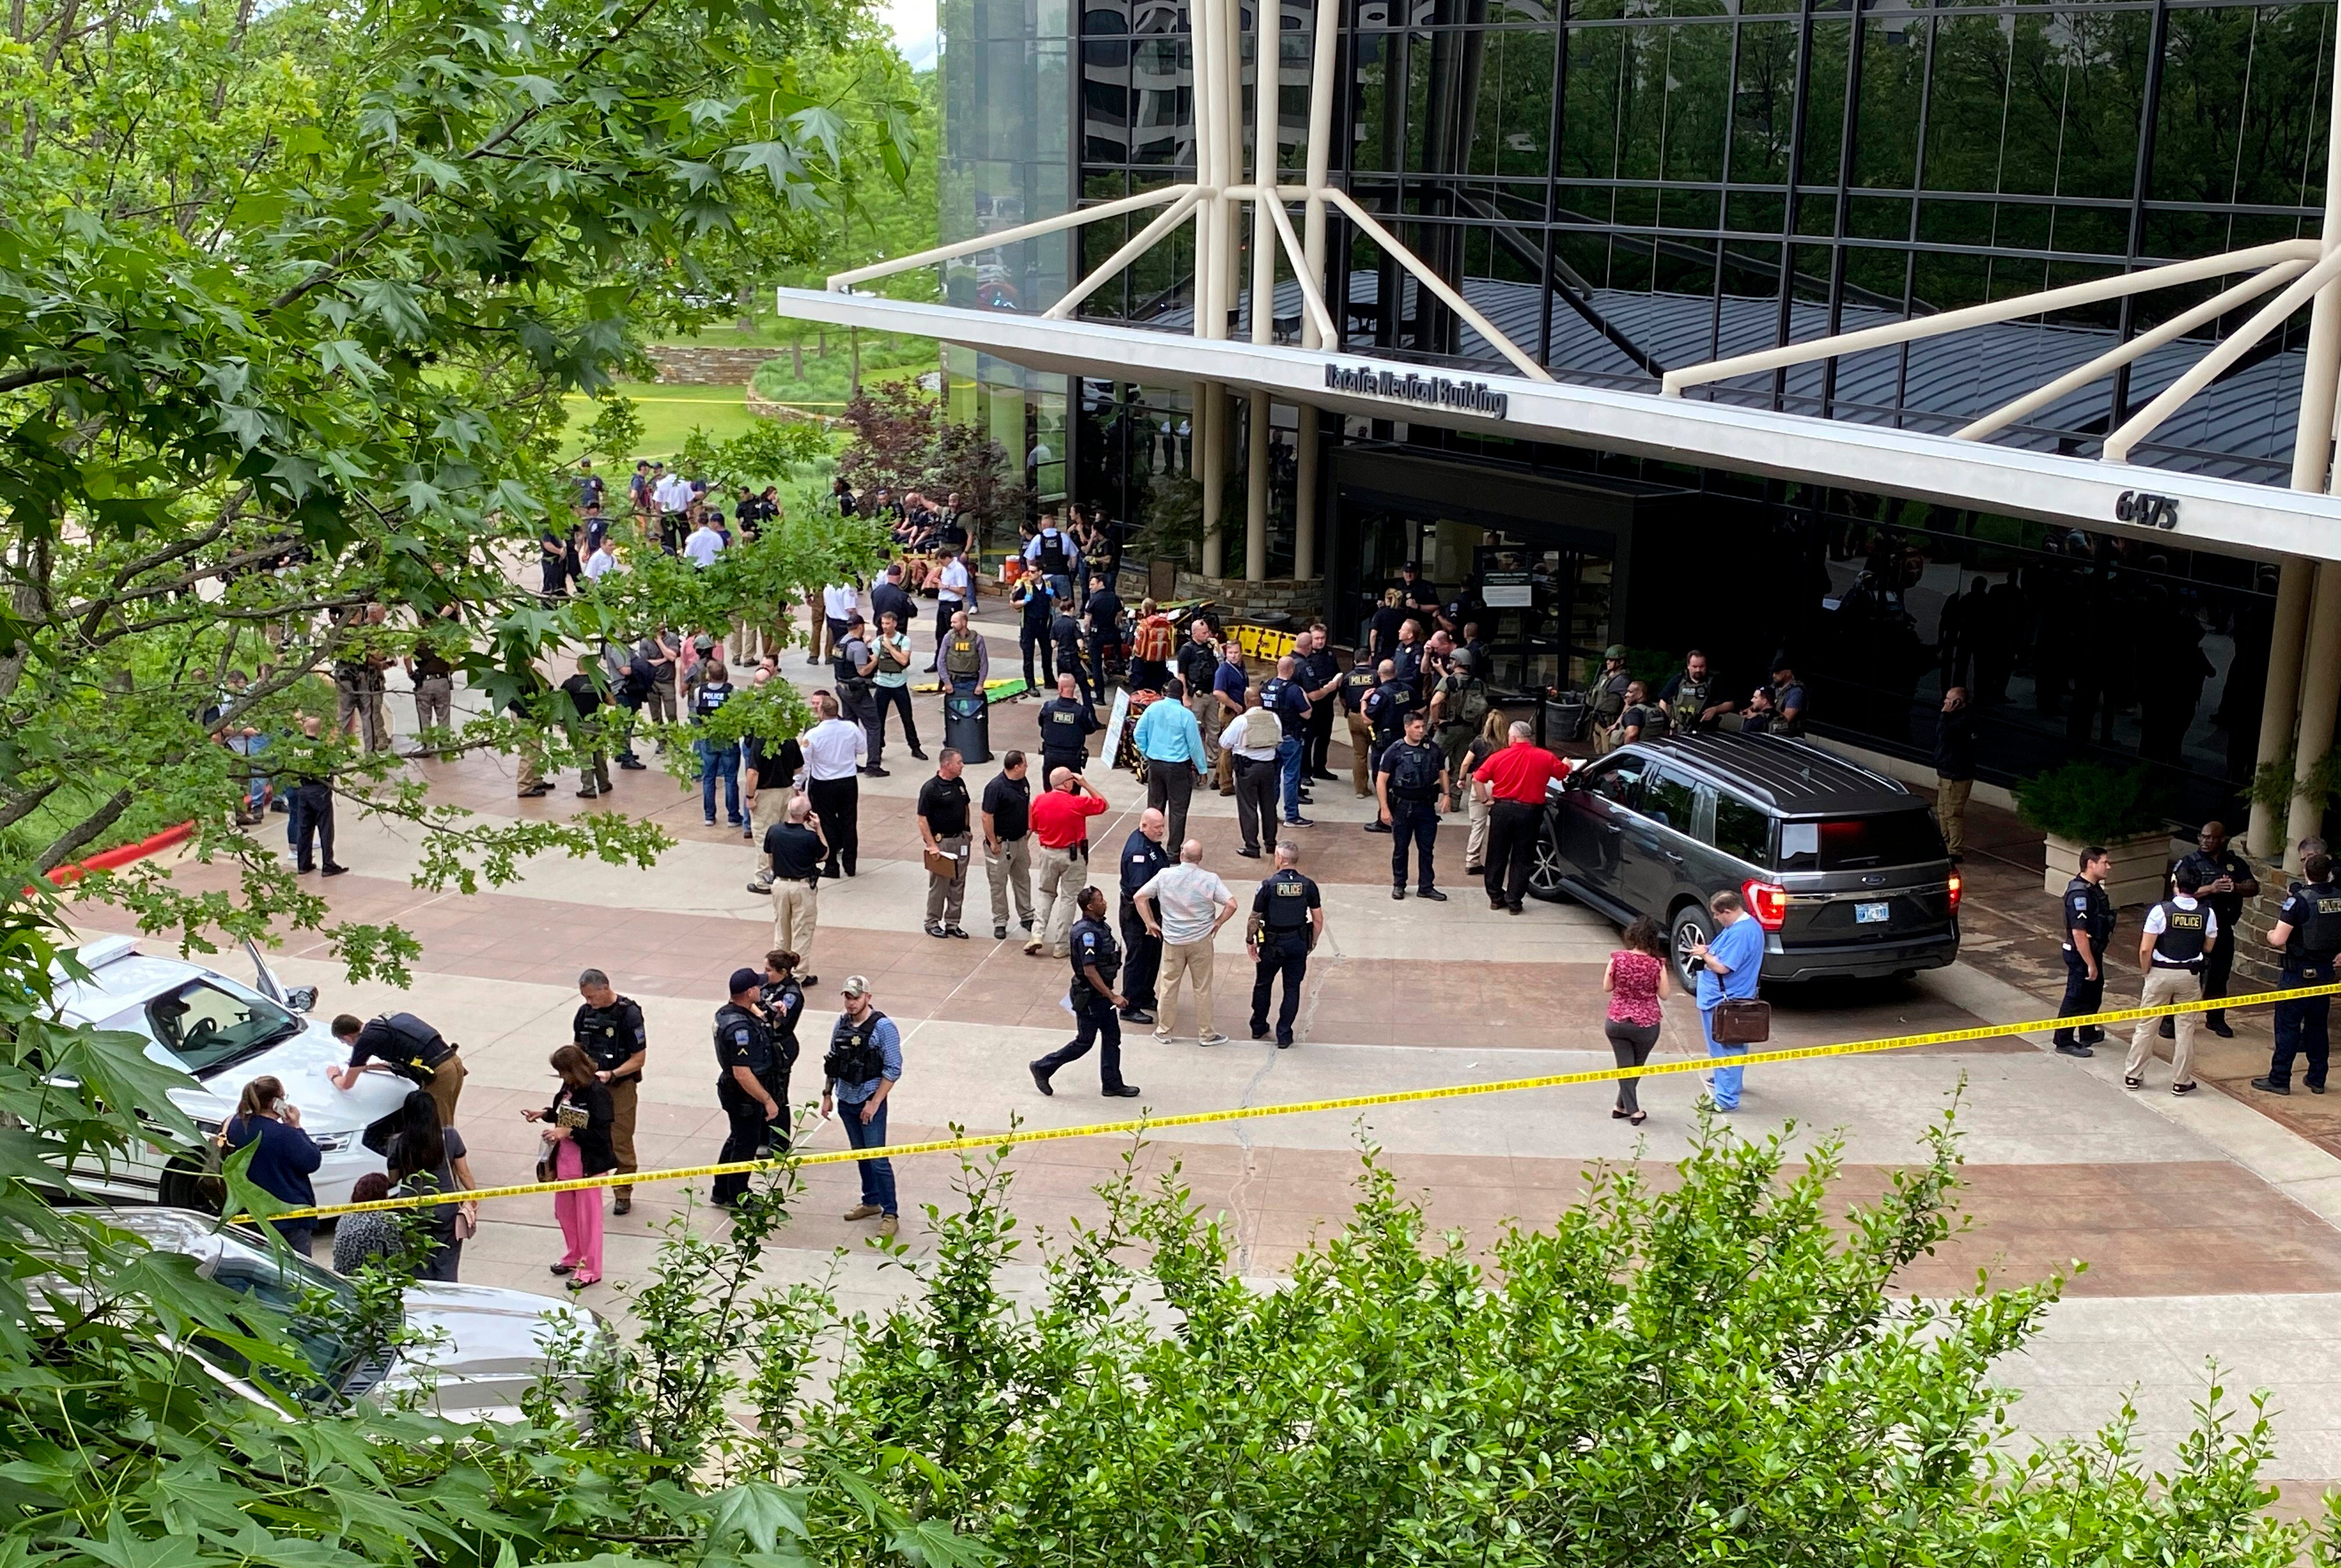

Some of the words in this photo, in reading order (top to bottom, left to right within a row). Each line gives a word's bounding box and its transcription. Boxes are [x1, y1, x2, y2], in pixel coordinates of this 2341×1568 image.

[1325, 363, 1377, 393] Natalie
[1378, 371, 1438, 403] Medical
[1439, 379, 1507, 420] Building
[2116, 491, 2179, 529] 6475
[955, 642, 969, 650] FBI
[1350, 675, 1372, 684] POLICE
[1278, 884, 1301, 895] POLICE
[2175, 917, 2199, 927] POLICE
